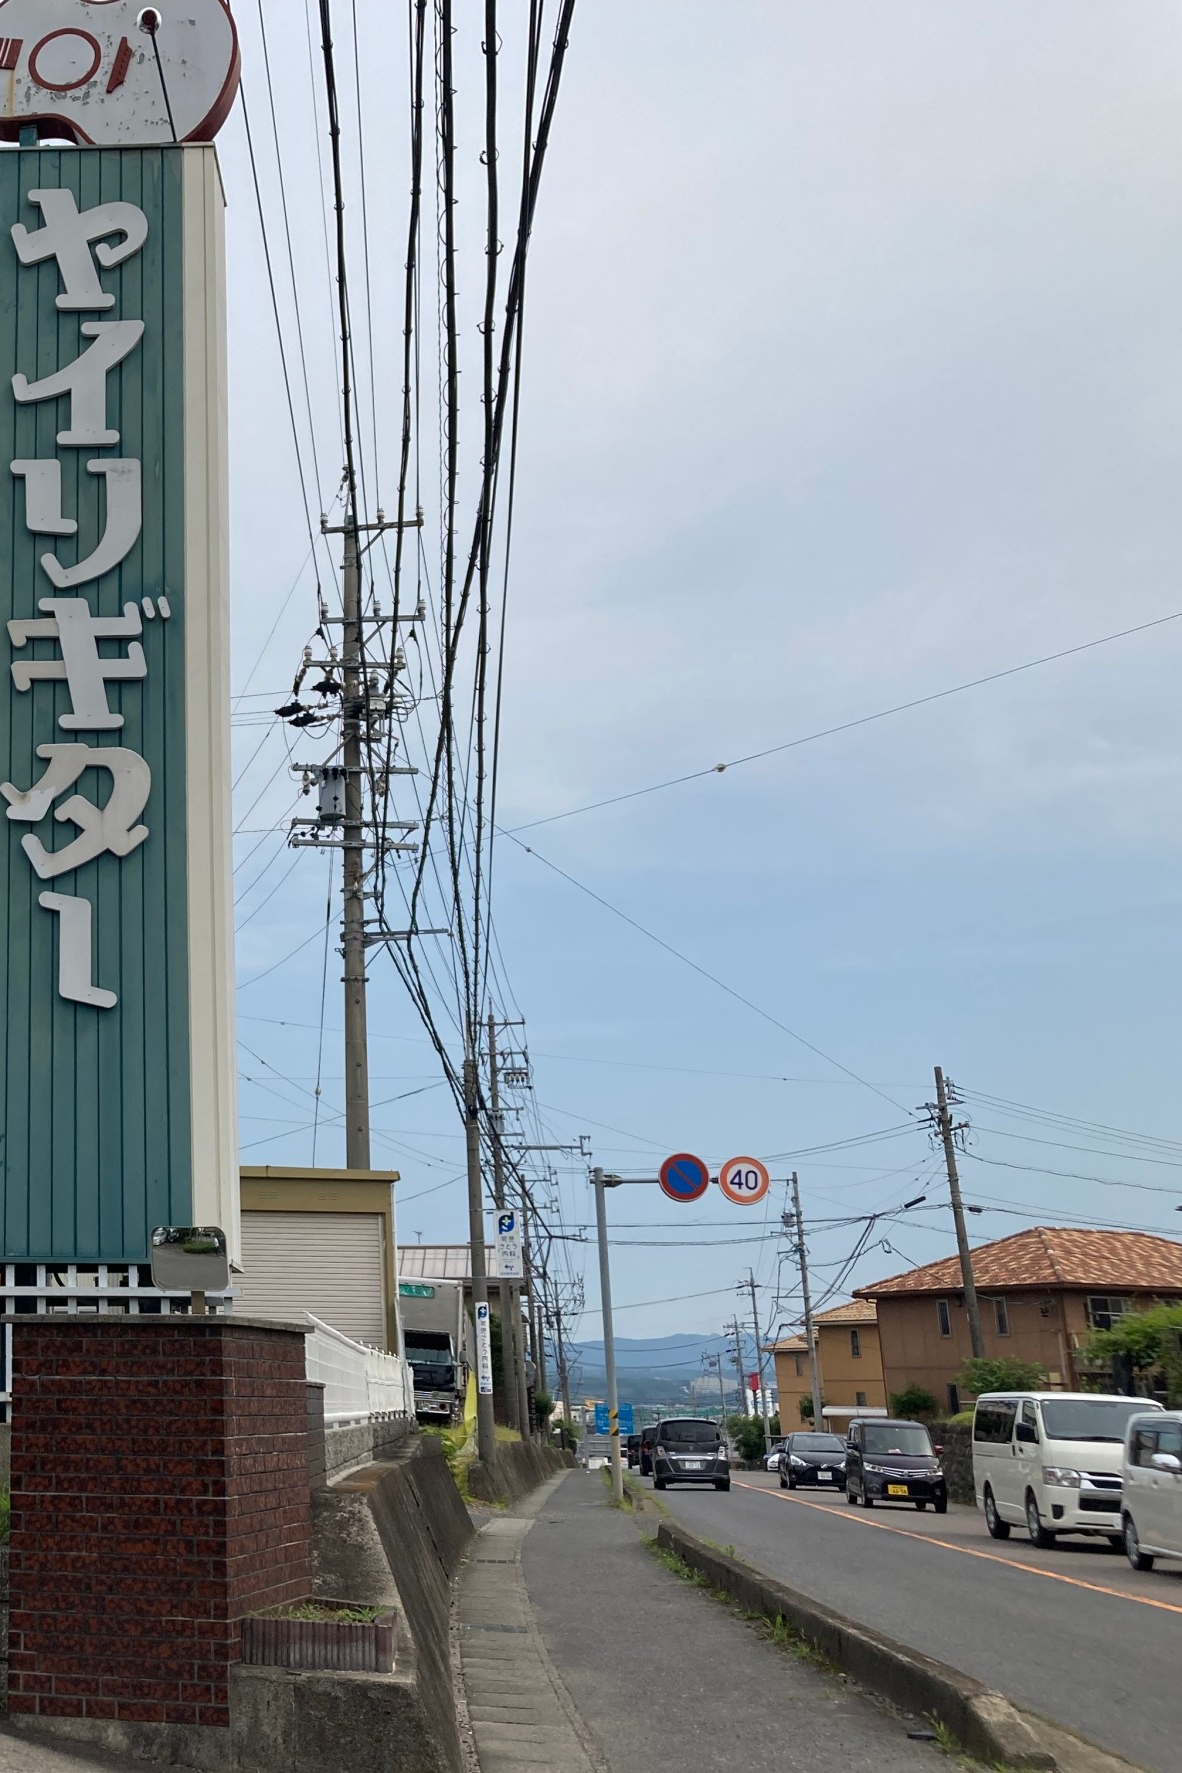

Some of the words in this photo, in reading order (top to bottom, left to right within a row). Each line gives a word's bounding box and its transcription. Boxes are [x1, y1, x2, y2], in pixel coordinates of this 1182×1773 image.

[0, 187, 171, 1010] ヤイリギター
[729, 1169, 758, 1191] 40
